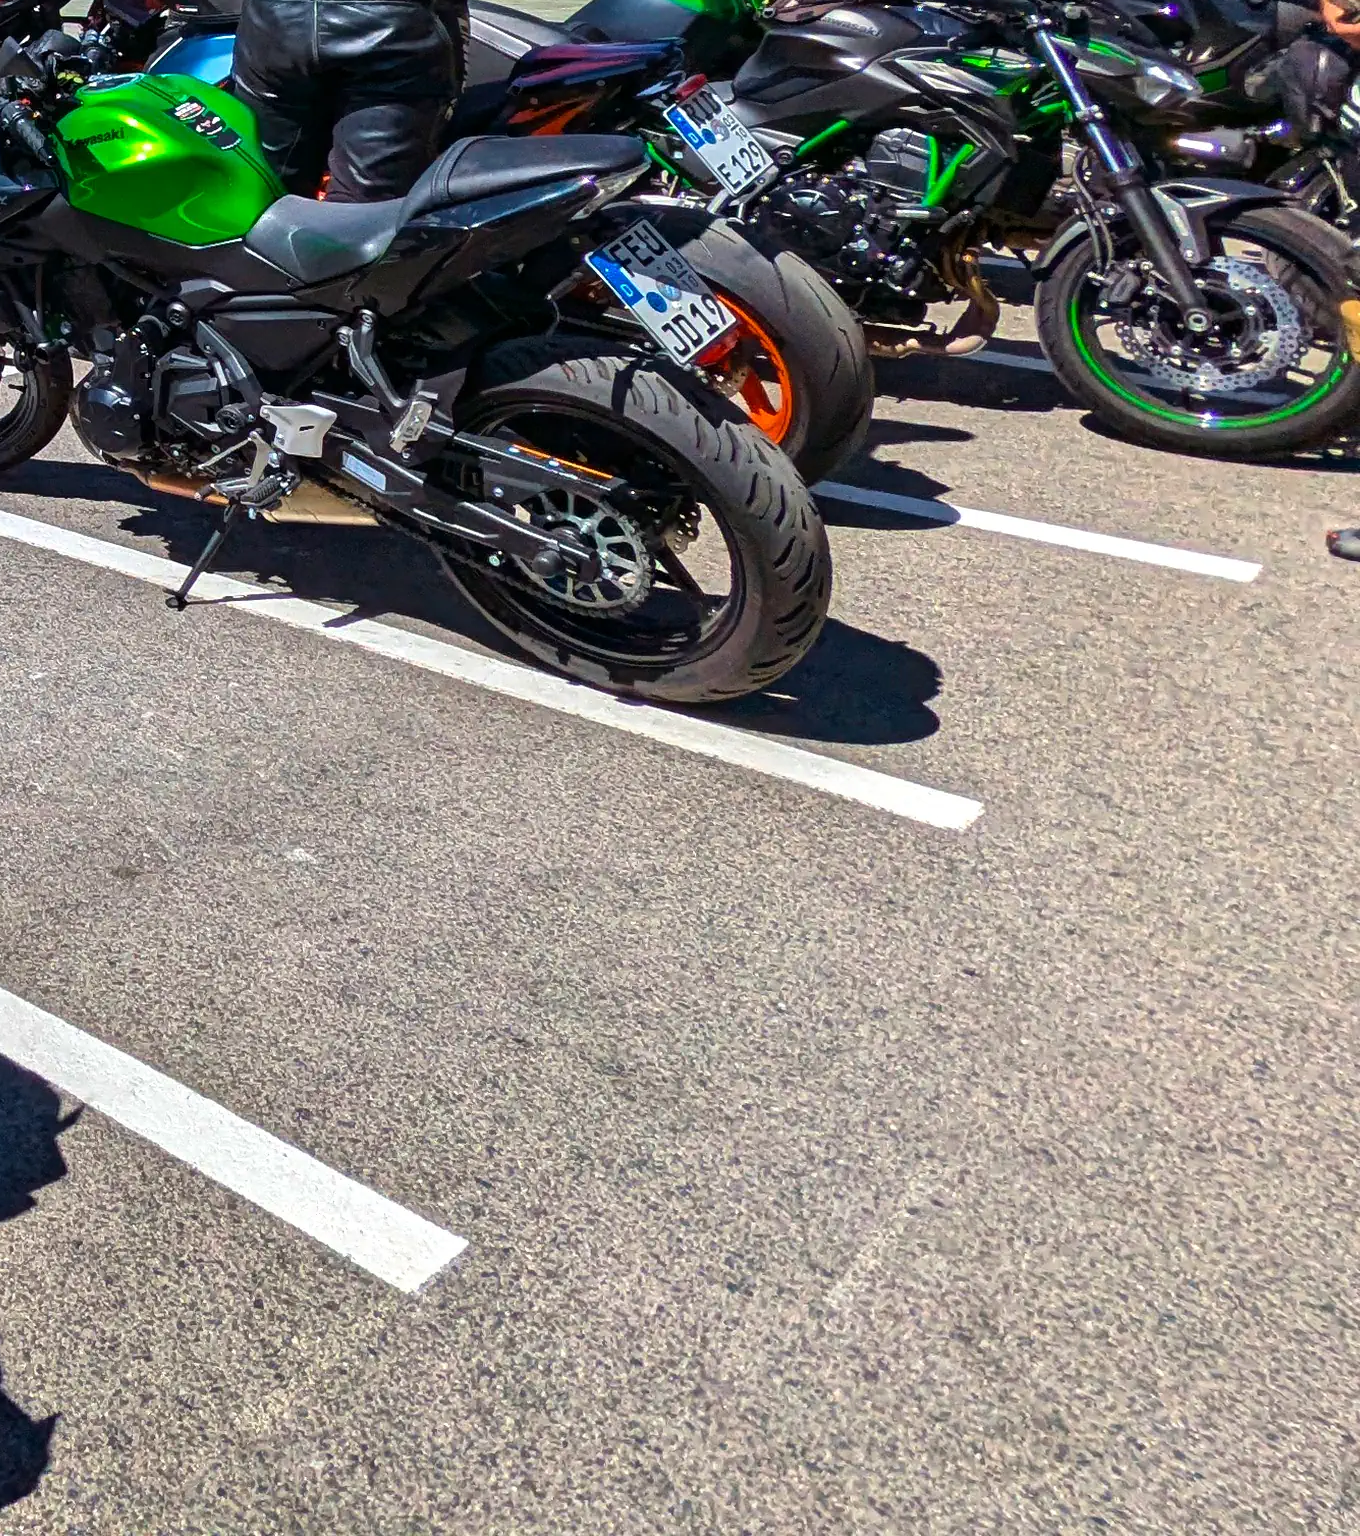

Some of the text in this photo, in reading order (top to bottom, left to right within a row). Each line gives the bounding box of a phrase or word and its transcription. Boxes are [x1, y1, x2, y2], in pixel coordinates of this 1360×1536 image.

[717, 140, 767, 190] E 129
[608, 223, 669, 278] FEU
[620, 283, 634, 297] D
[660, 292, 728, 358] JD 19
